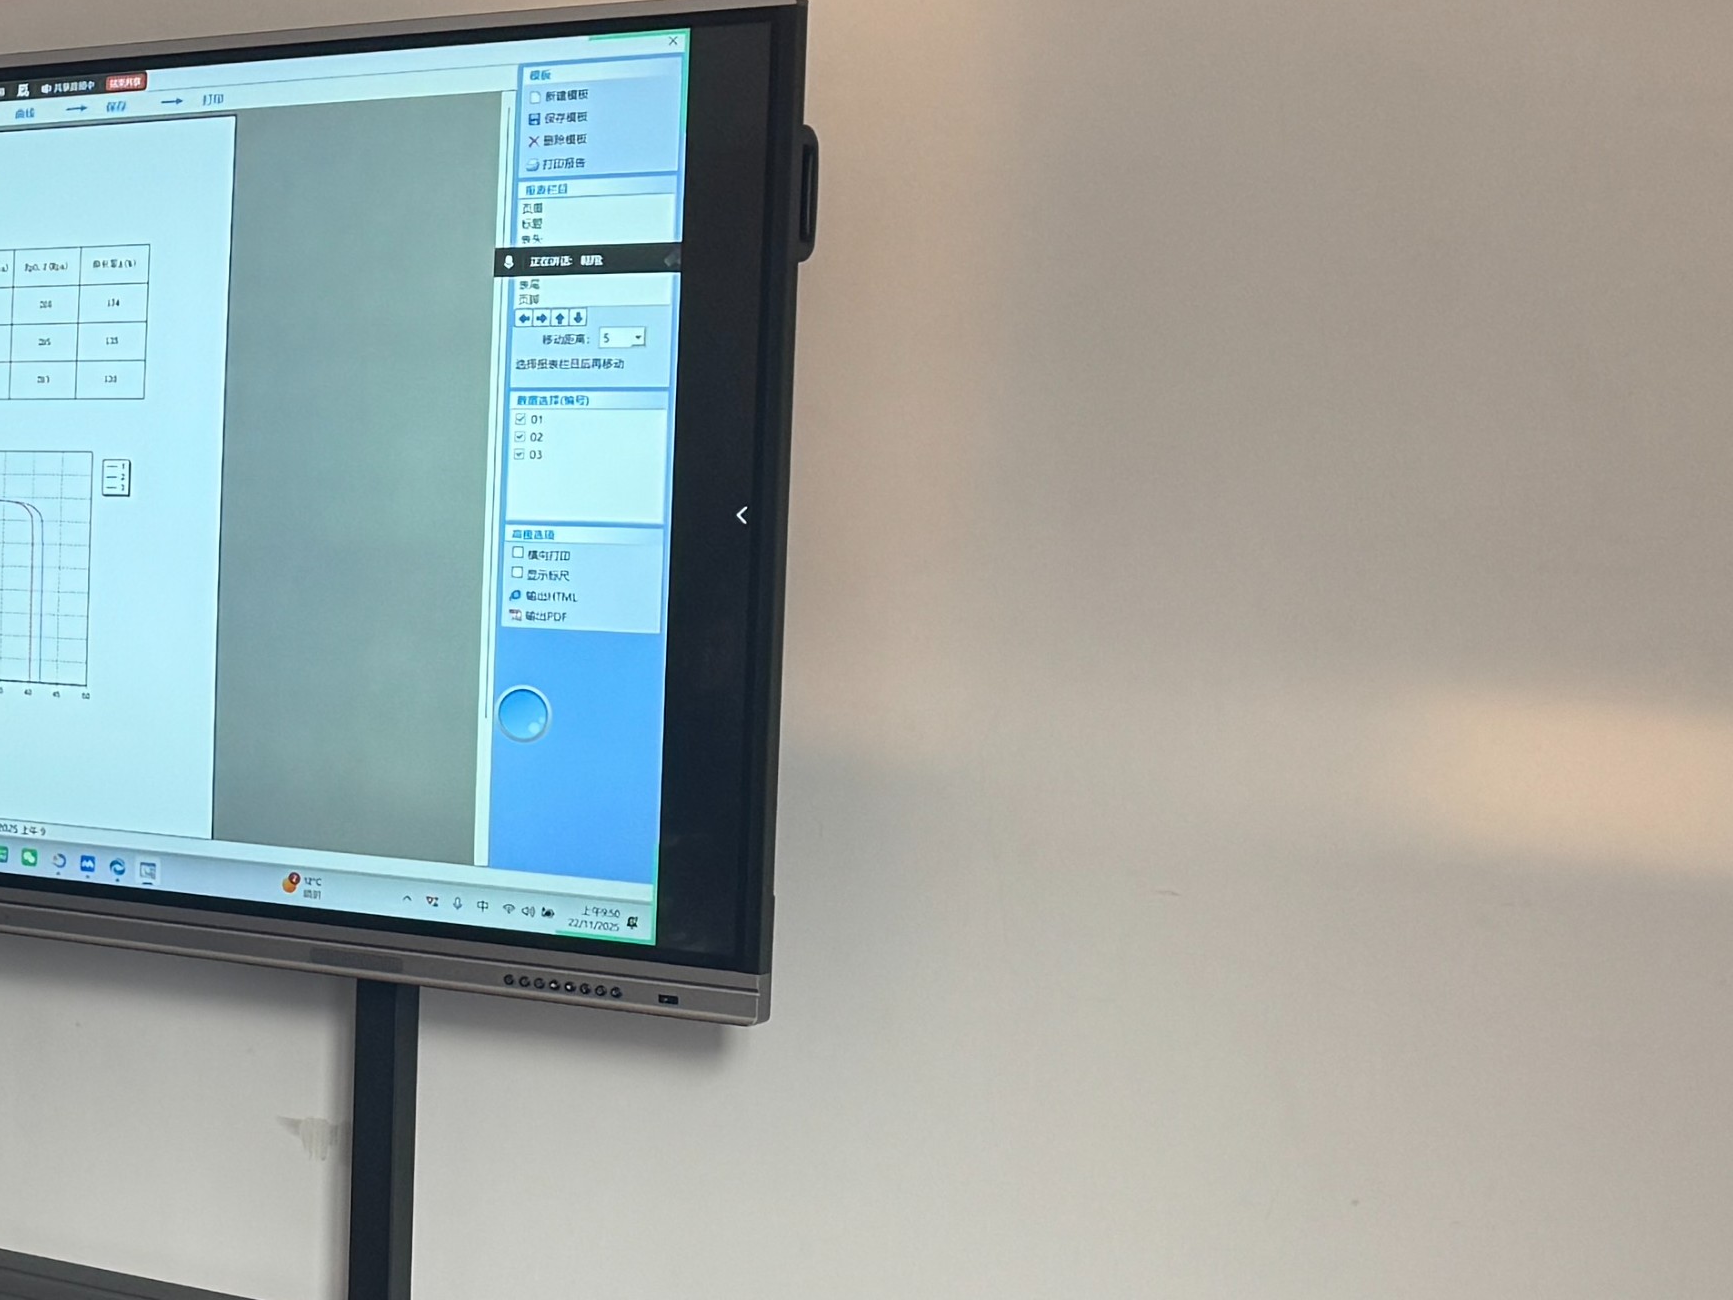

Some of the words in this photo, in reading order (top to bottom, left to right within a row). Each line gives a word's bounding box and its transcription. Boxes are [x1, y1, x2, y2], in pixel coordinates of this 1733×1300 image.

[602, 332, 610, 344] 5
[530, 414, 543, 425] 01
[529, 432, 544, 443] 02
[529, 449, 543, 460] 03
[476, 899, 489, 912] 中
[567, 917, 620, 932] 22/11/2025
